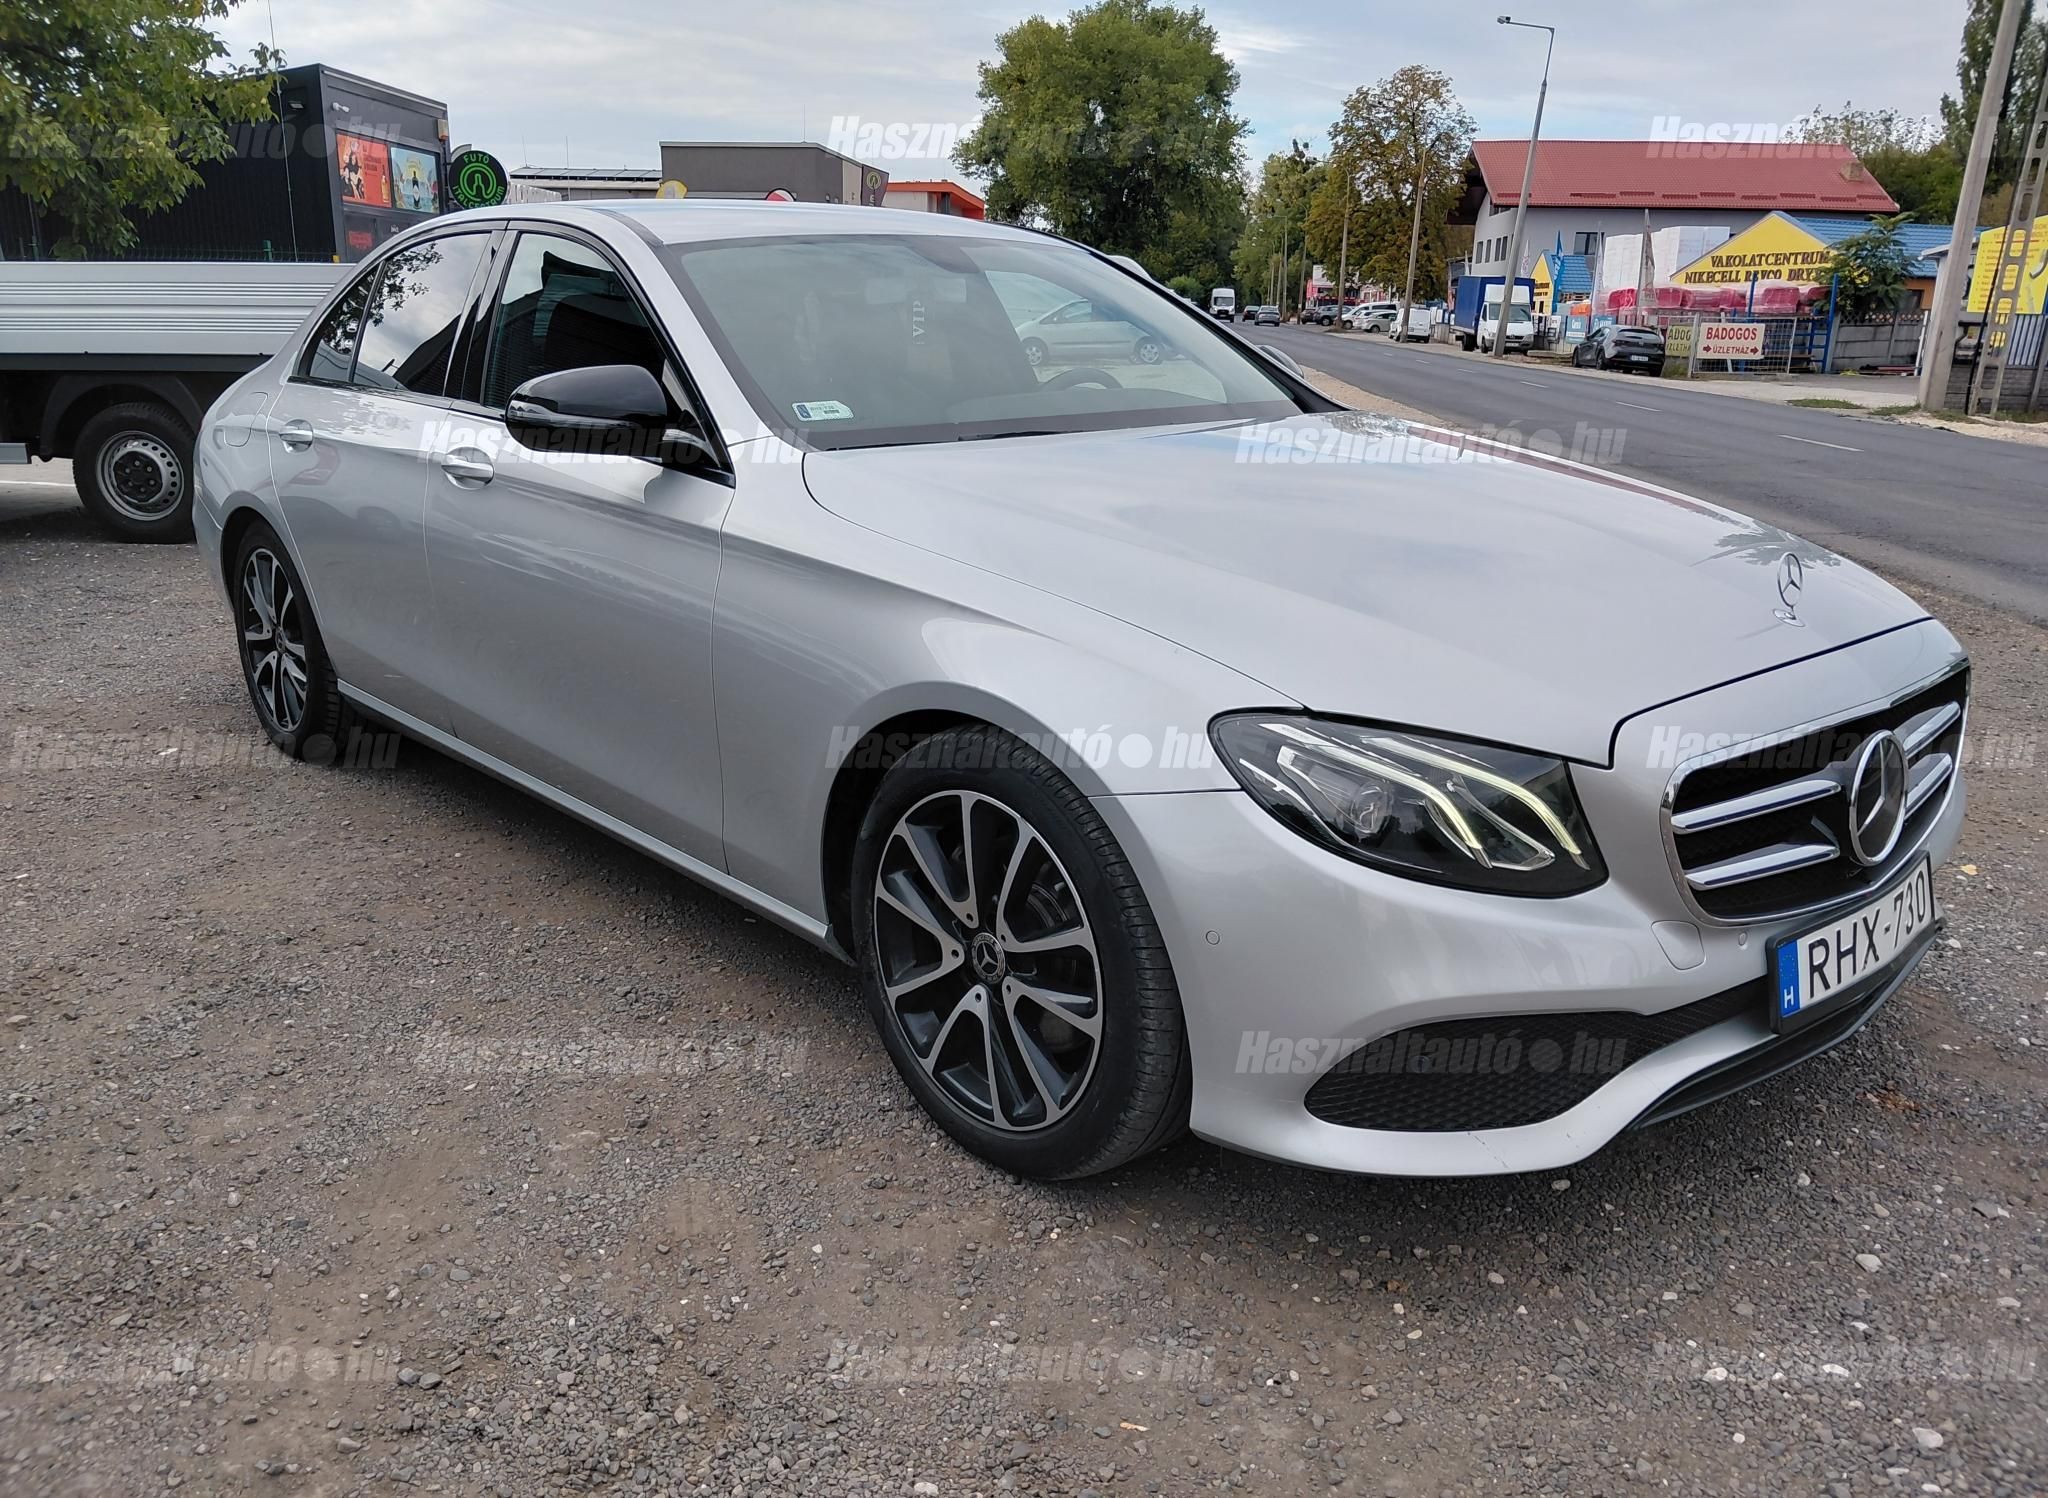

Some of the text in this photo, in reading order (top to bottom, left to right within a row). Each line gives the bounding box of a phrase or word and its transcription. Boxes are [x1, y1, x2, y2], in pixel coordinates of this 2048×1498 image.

[913, 300, 925, 337] VIP
[1807, 870, 1926, 999] RHX-730
[1783, 985, 1795, 1009] H
